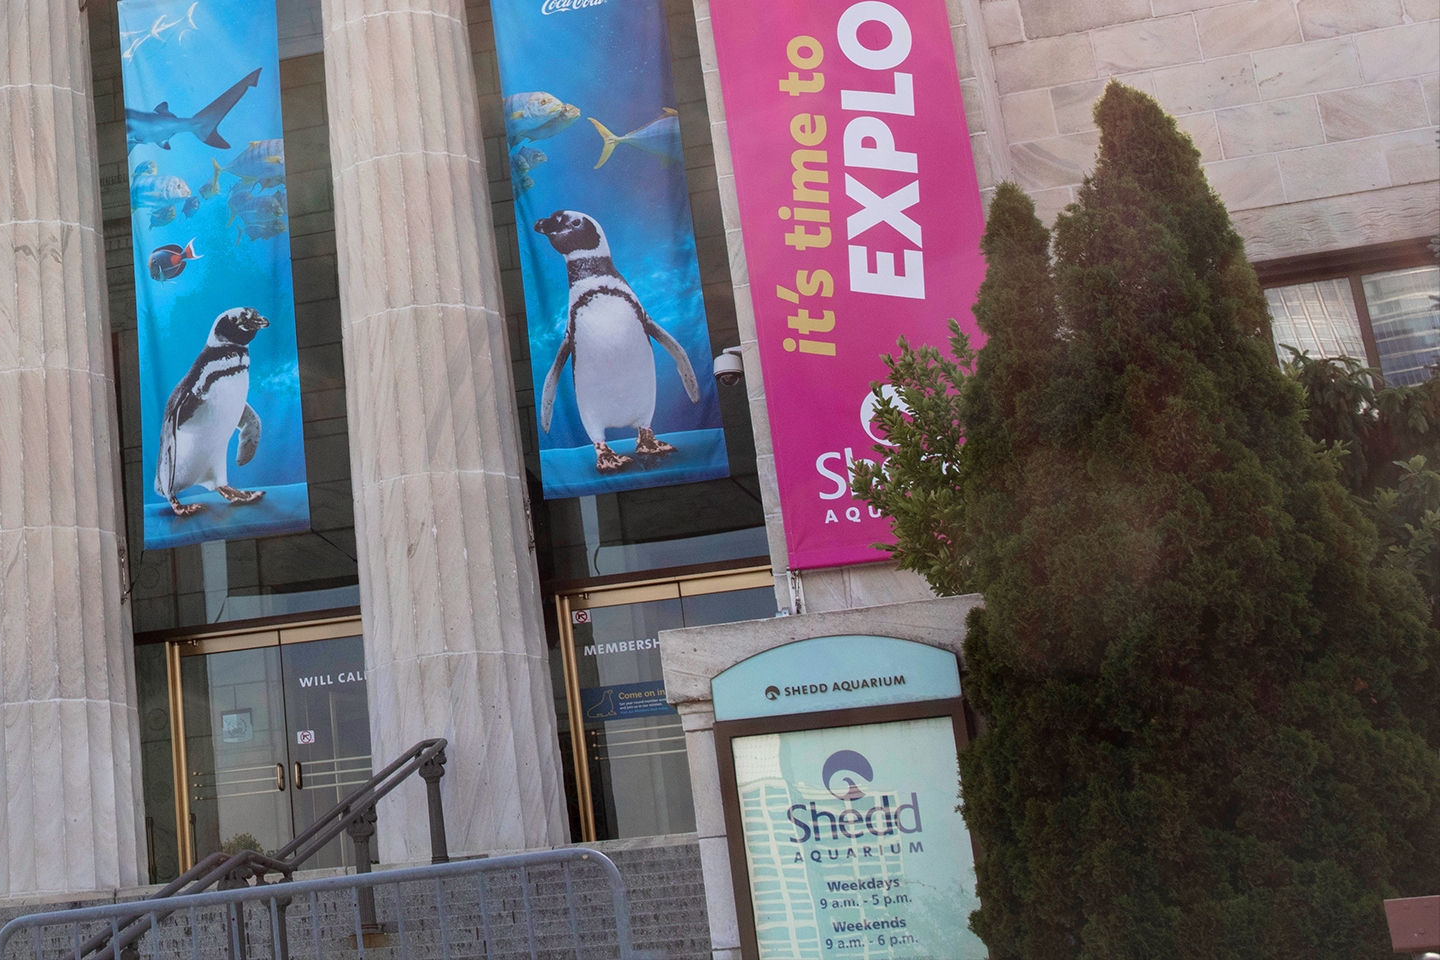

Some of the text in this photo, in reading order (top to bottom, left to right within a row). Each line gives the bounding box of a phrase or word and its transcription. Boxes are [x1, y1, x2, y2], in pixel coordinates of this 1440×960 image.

[776, 35, 837, 356] it's time to
[299, 674, 333, 688] WILL
[784, 675, 906, 697] SHEDD AQUARIUM
[618, 691, 642, 700] Come
[787, 792, 923, 843] Shedd
[794, 841, 924, 863] AQUARIUM
[827, 878, 900, 892] Weekdays
[820, 898, 828, 909] 9
[831, 900, 859, 908] a.m.
[872, 894, 879, 906] 5
[884, 894, 912, 907] p.m.
[832, 916, 907, 933] Weekends
[825, 937, 833, 950] 9
[837, 939, 865, 949] a.m.
[877, 934, 886, 946] 6
[889, 934, 918, 948] p.m.
